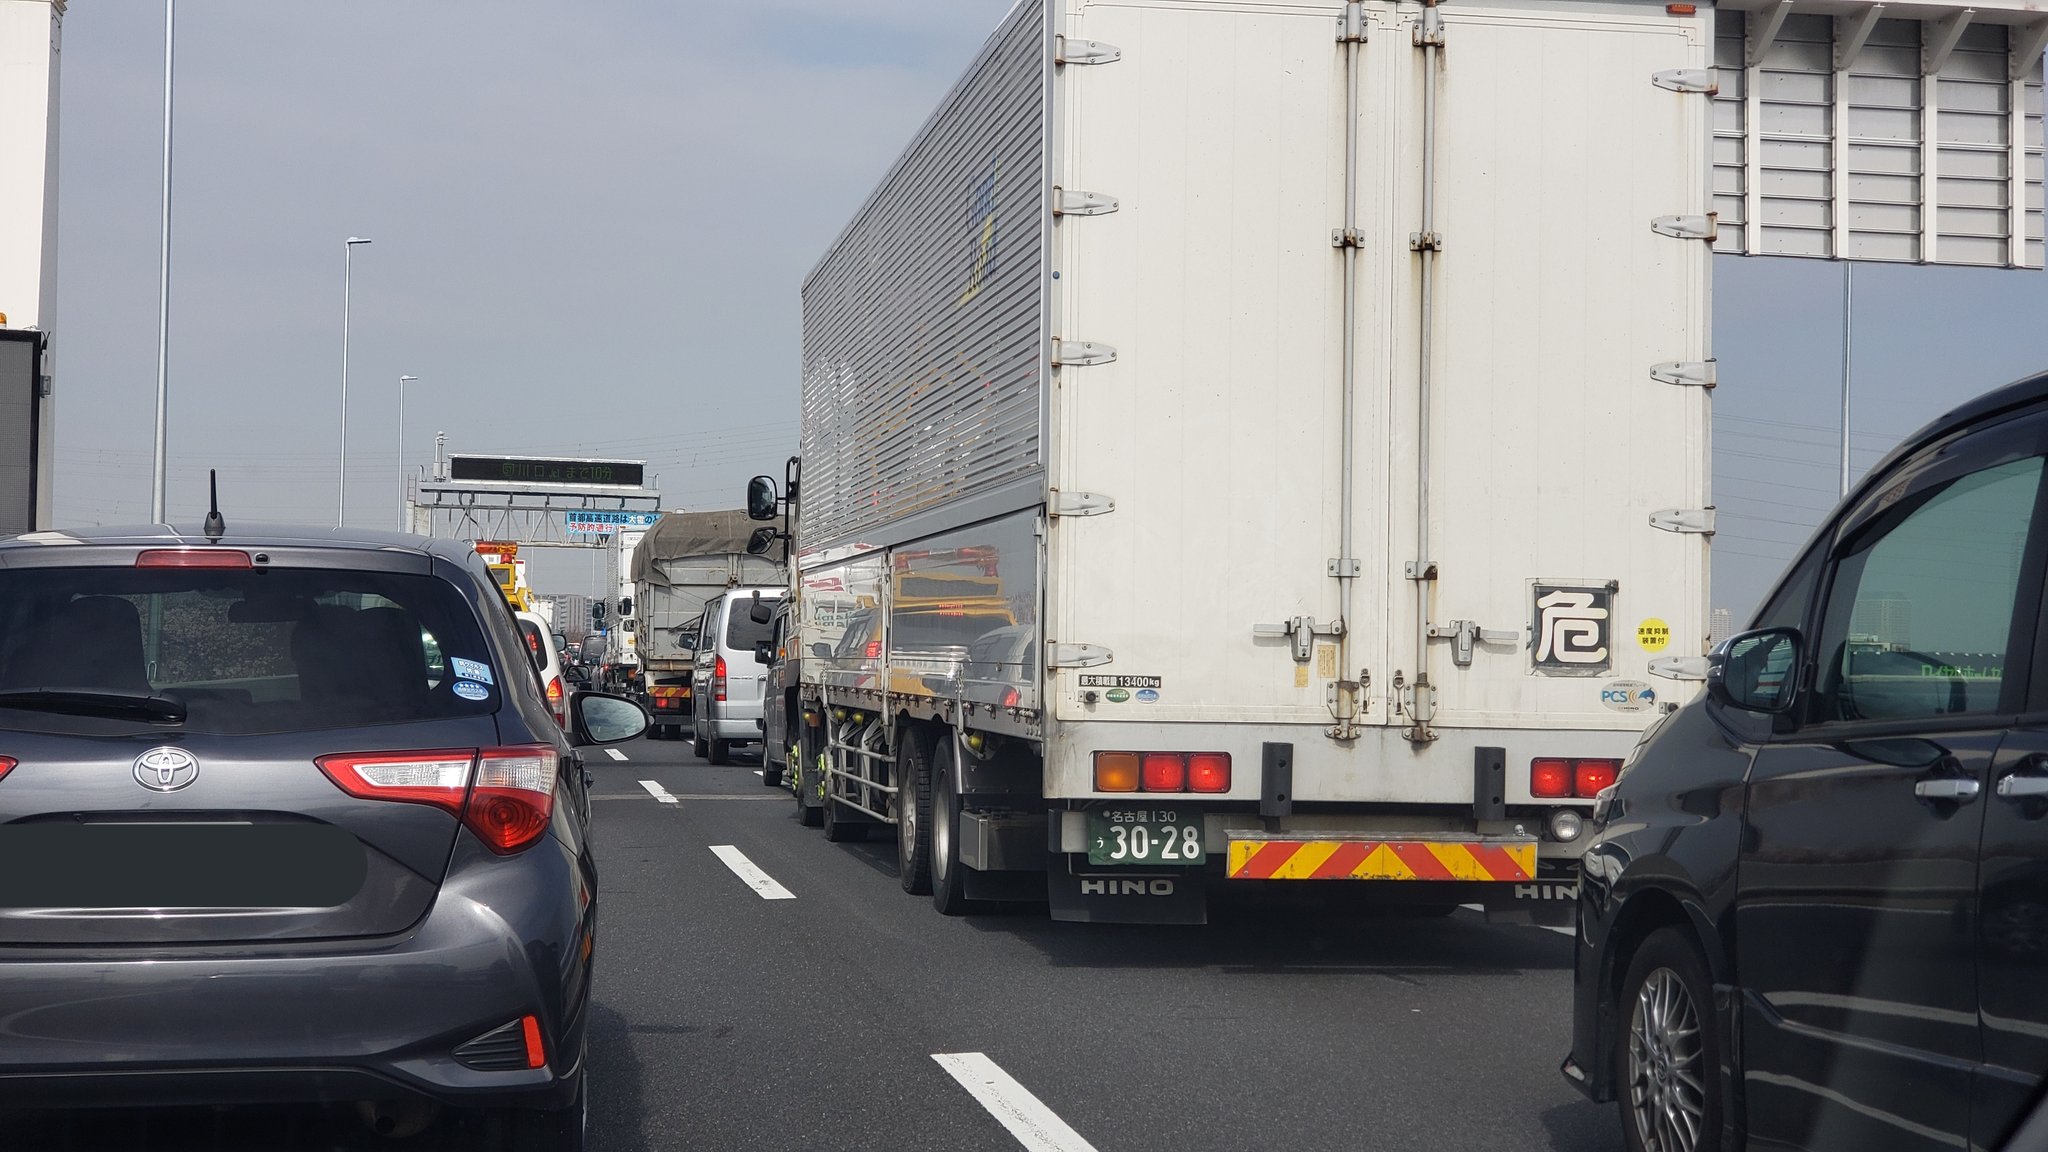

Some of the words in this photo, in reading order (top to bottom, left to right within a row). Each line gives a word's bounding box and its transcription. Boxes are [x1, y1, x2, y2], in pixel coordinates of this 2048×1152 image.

[1536, 590, 1608, 663] 危
[1638, 627, 1669, 635] 速度抑制
[1642, 637, 1665, 645] 装置付
[1602, 690, 1628, 703] PCS
[1111, 811, 1148, 823] 名古屋
[1152, 811, 1177, 823] 130
[1109, 825, 1200, 860] 30-28
[1081, 880, 1174, 896] HINO
